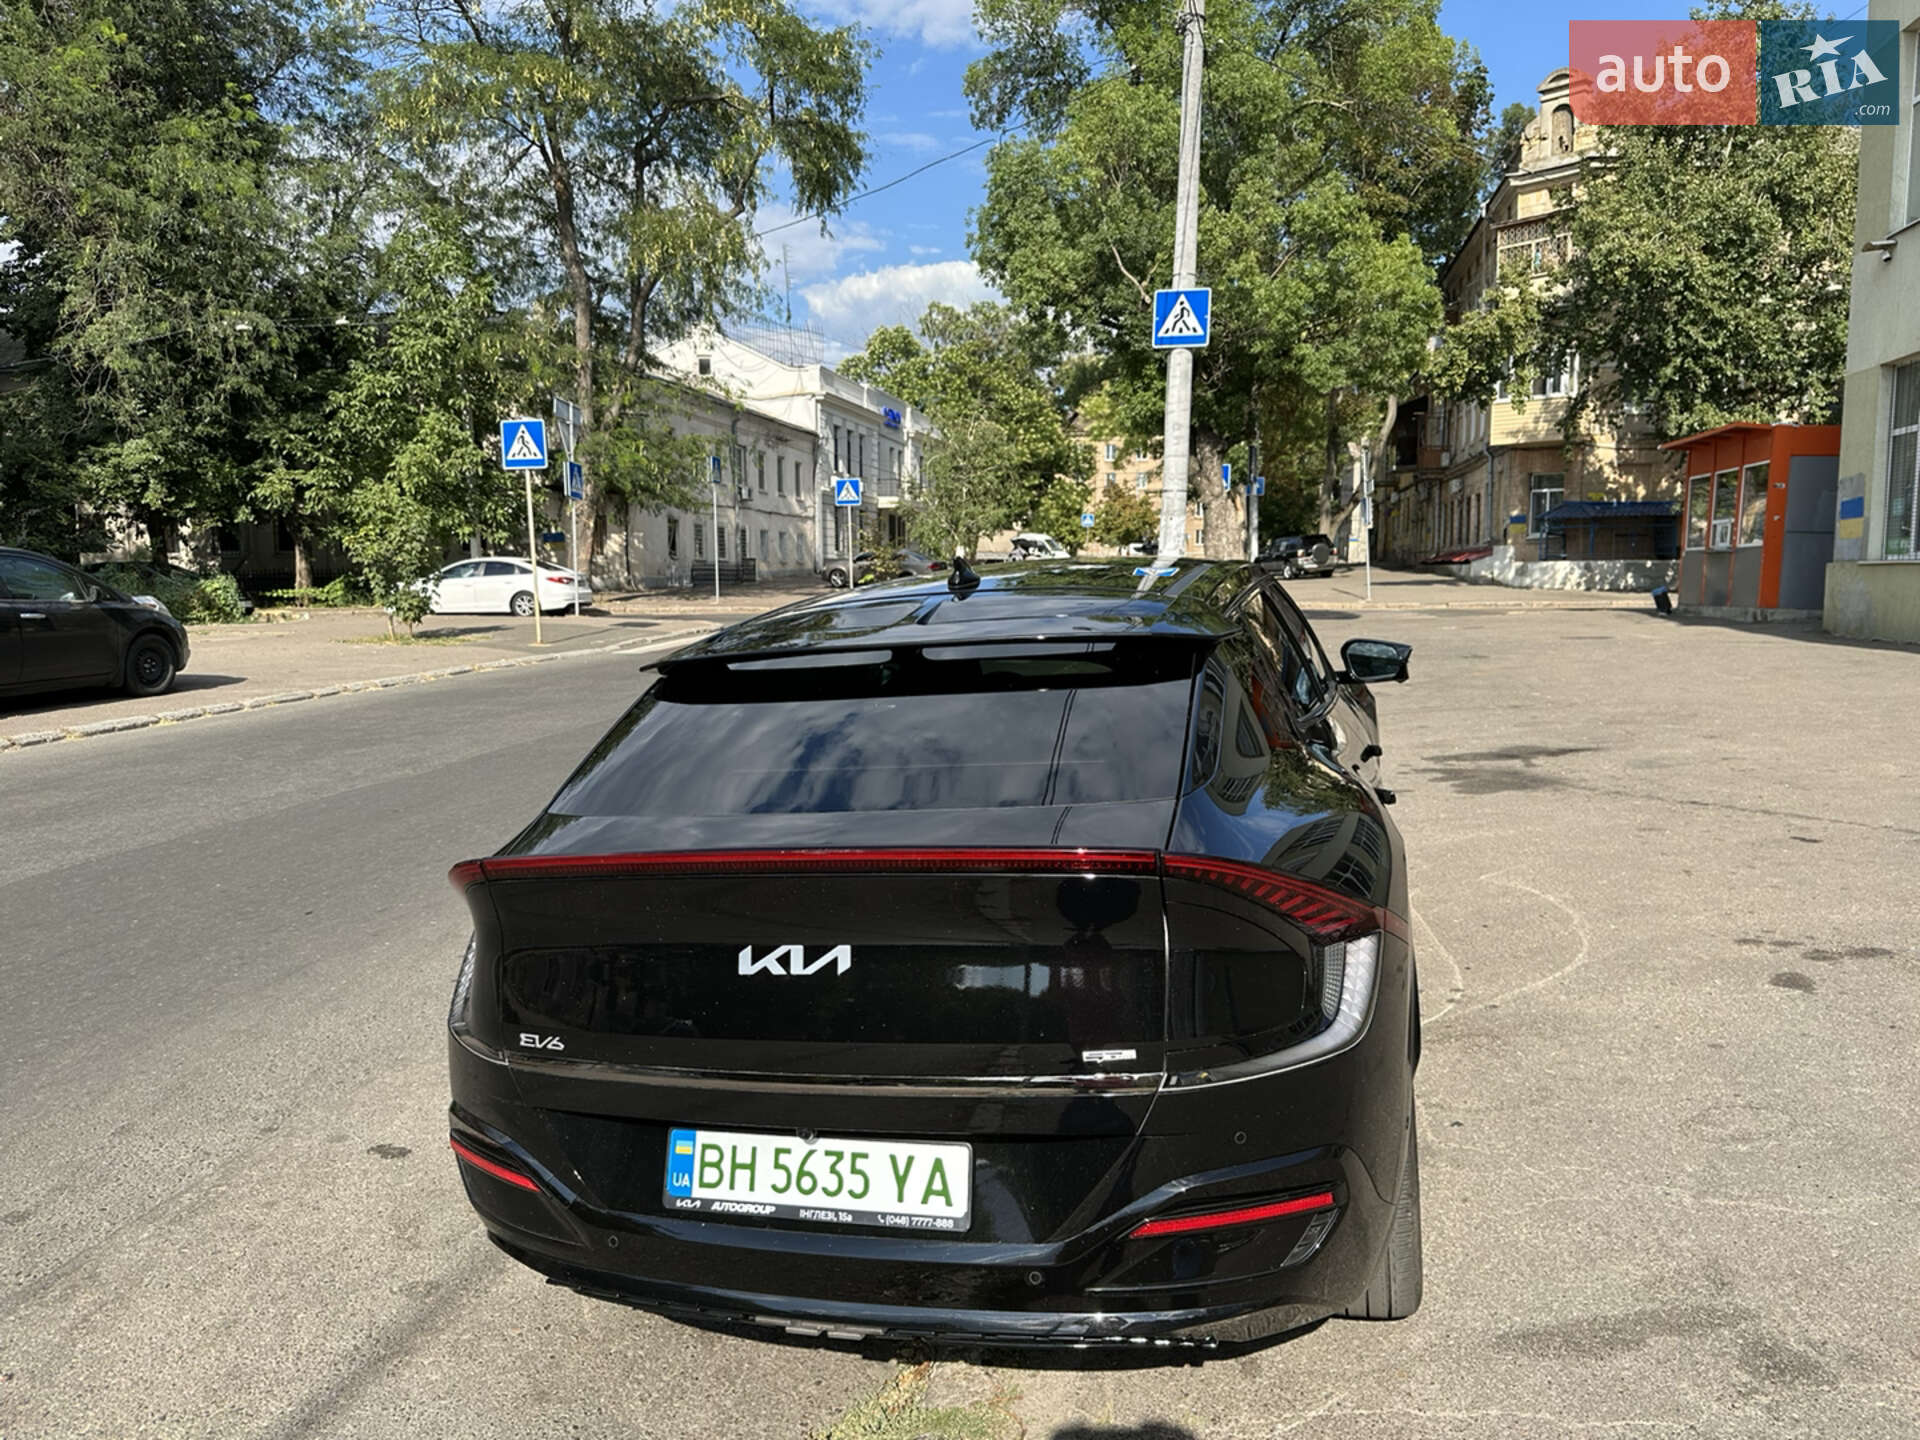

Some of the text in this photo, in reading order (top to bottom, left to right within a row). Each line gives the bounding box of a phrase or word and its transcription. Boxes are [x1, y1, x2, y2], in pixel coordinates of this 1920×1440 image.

[738, 944, 851, 975] KIA
[520, 1033, 565, 1050] EV6
[673, 1172, 690, 1187] UA
[698, 1143, 953, 1207] BH 5635 YA
[711, 1201, 776, 1214] AUTOGROUP
